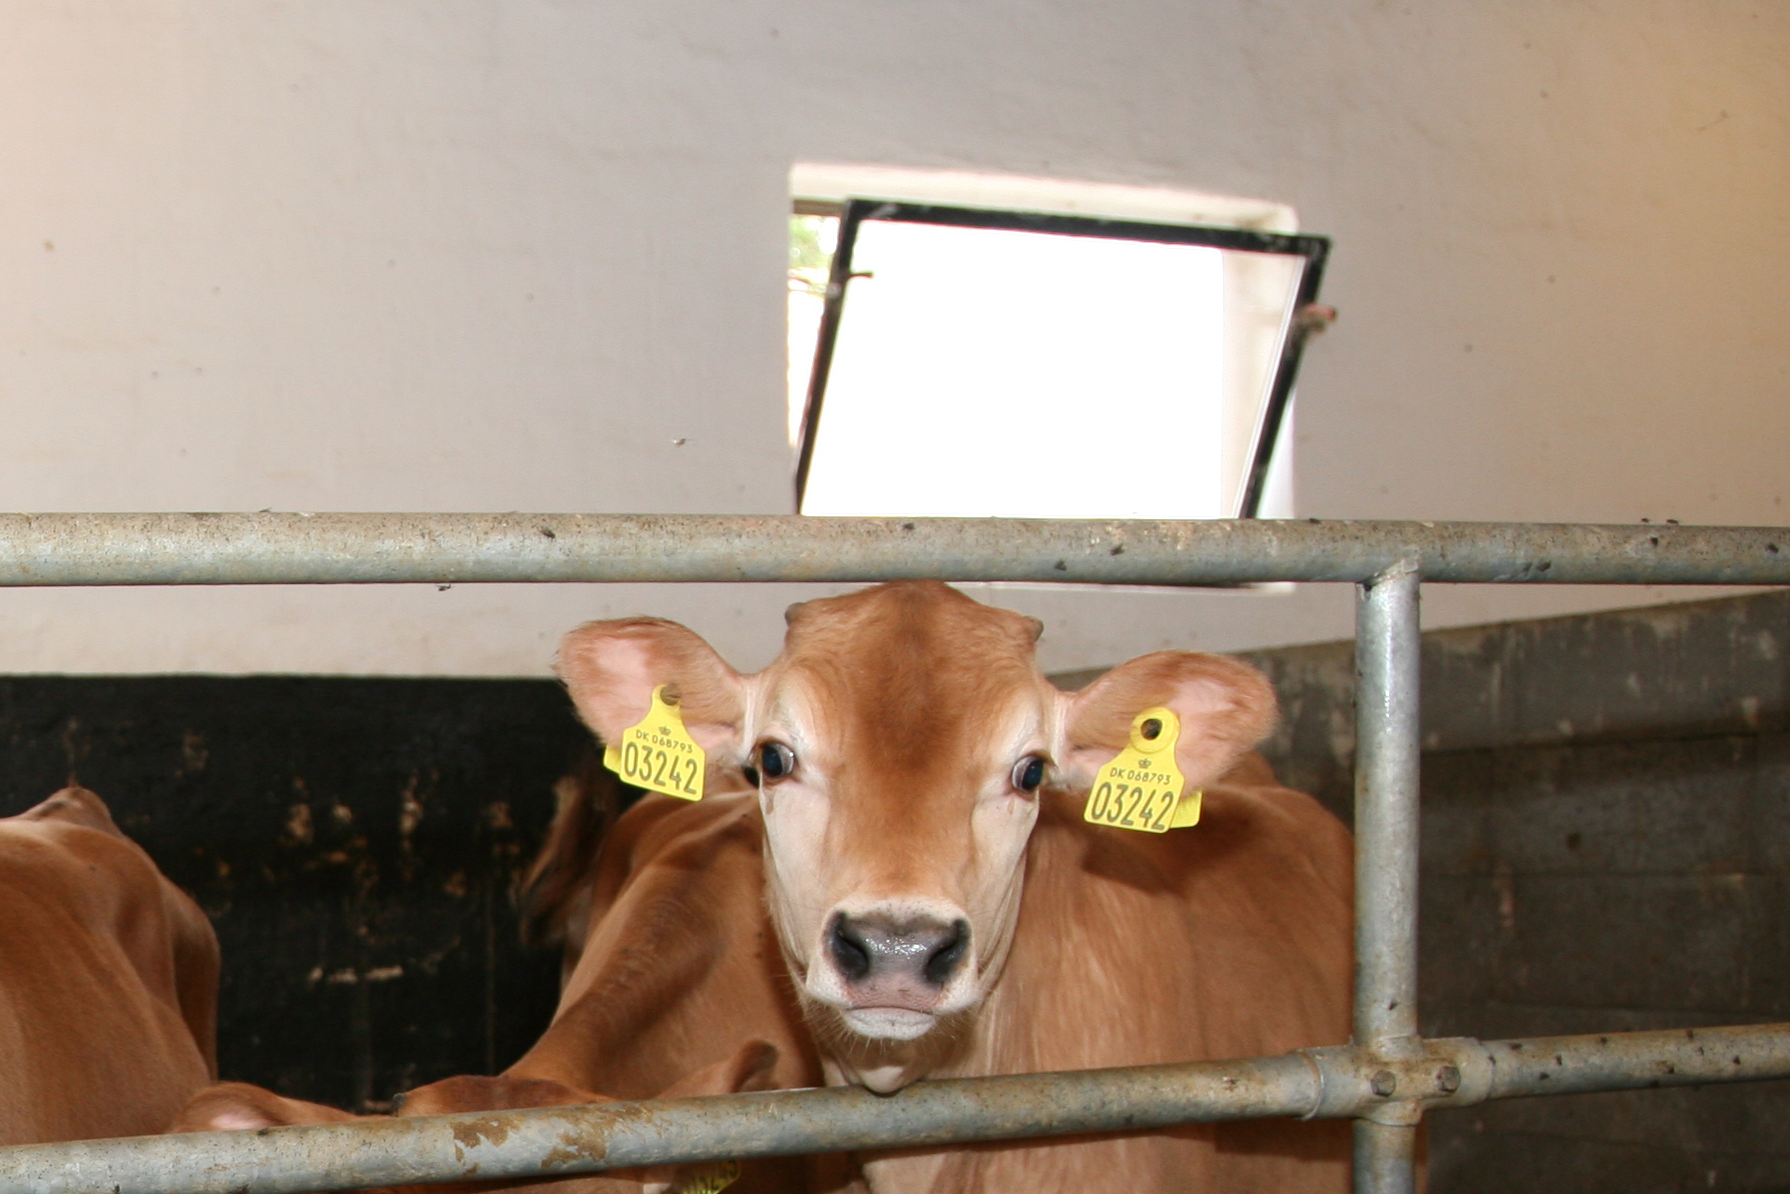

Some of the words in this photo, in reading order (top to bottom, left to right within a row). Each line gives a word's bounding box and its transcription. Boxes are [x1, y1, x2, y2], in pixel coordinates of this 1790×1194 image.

[636, 729, 649, 742] DK
[651, 734, 693, 754] 068793
[624, 741, 698, 795] 03242
[1109, 767, 1126, 779] DK
[1127, 769, 1171, 785] 068793
[1091, 781, 1174, 831] 03242
